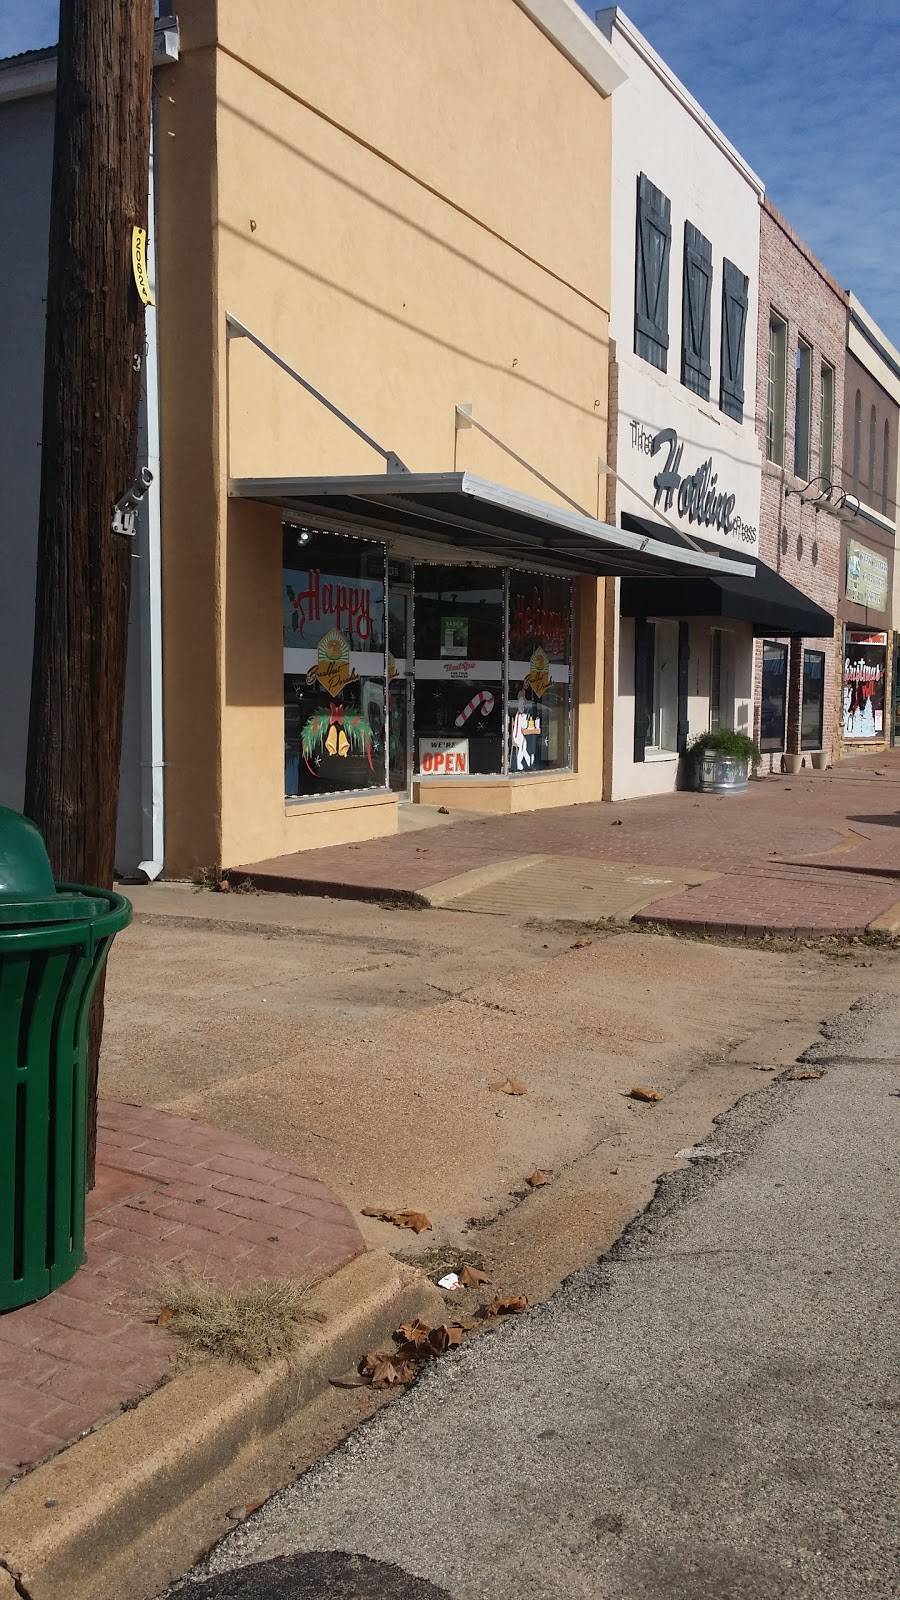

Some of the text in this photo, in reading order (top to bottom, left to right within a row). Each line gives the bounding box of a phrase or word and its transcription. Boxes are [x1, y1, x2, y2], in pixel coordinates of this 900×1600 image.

[651, 427, 738, 535] Hotline
[294, 568, 374, 640] Happy
[422, 751, 467, 772] OPEN
[431, 741, 457, 749] WE'RE
